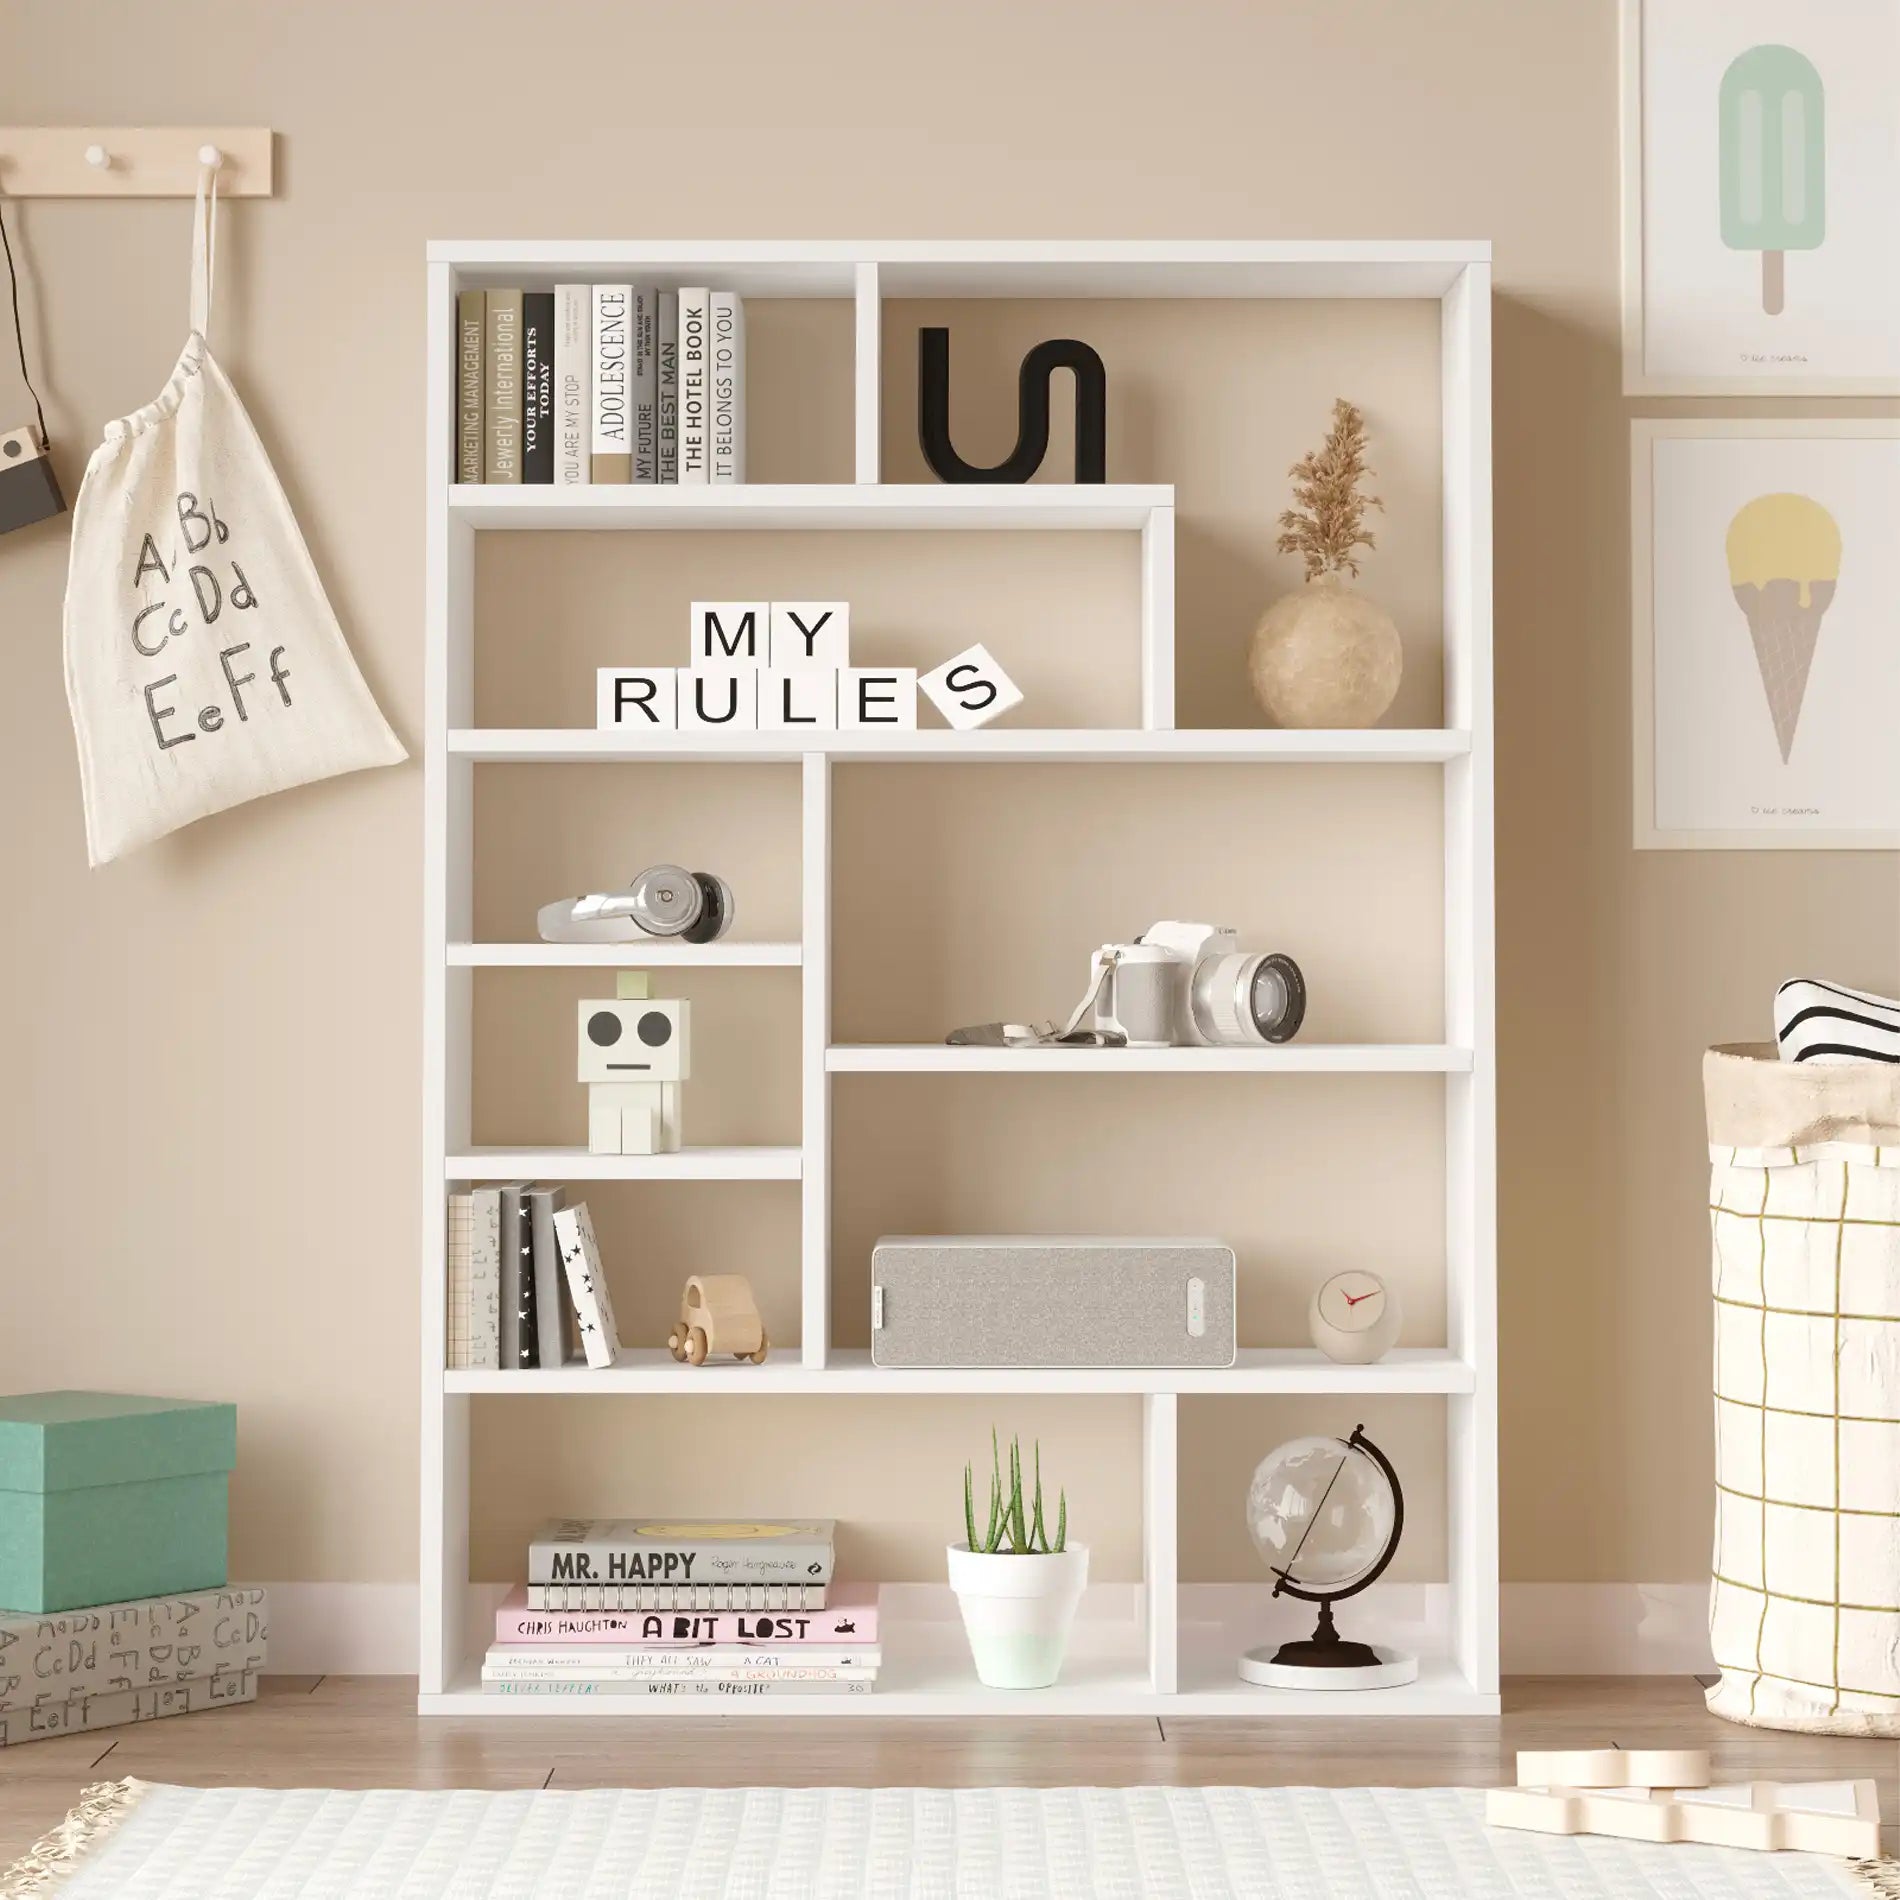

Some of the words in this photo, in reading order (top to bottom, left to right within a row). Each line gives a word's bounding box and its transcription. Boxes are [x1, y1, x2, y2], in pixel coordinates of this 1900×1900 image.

[686, 307, 703, 361] BOOK
[716, 306, 733, 343] YOU
[463, 319, 480, 408] MANAGEMENT
[491, 308, 515, 410] International
[526, 327, 537, 401] EFFORTS
[600, 292, 625, 441] ADOLESCENCE
[660, 342, 676, 385] MAN
[716, 349, 733, 371] TO
[539, 362, 550, 419] TODAY
[564, 374, 580, 406] STOP
[686, 368, 703, 429] HOTEL
[526, 407, 537, 453] YOUR
[564, 410, 580, 428] MY
[637, 404, 652, 455] FUTURE
[660, 391, 676, 441] BEST
[716, 378, 733, 456] BELONGS
[463, 412, 480, 484] MARKETING
[491, 416, 519, 478] Jewerly
[564, 432, 580, 458] ARE
[660, 447, 676, 484] THE
[686, 436, 703, 472] THE
[564, 461, 580, 485] YOU
[636, 457, 652, 480] MY
[716, 461, 733, 477] IT
[704, 611, 833, 657] MY
[613, 664, 998, 723] RULES
[551, 1552, 599, 1579] MR.
[608, 1552, 697, 1579] HAPPY
[517, 1621, 552, 1635] CHRIS
[558, 1618, 628, 1634] HAUGHTON
[642, 1616, 663, 1638] A
[673, 1617, 719, 1639] BIT
[738, 1618, 810, 1639] LOST
[755, 1656, 781, 1666] CAT
